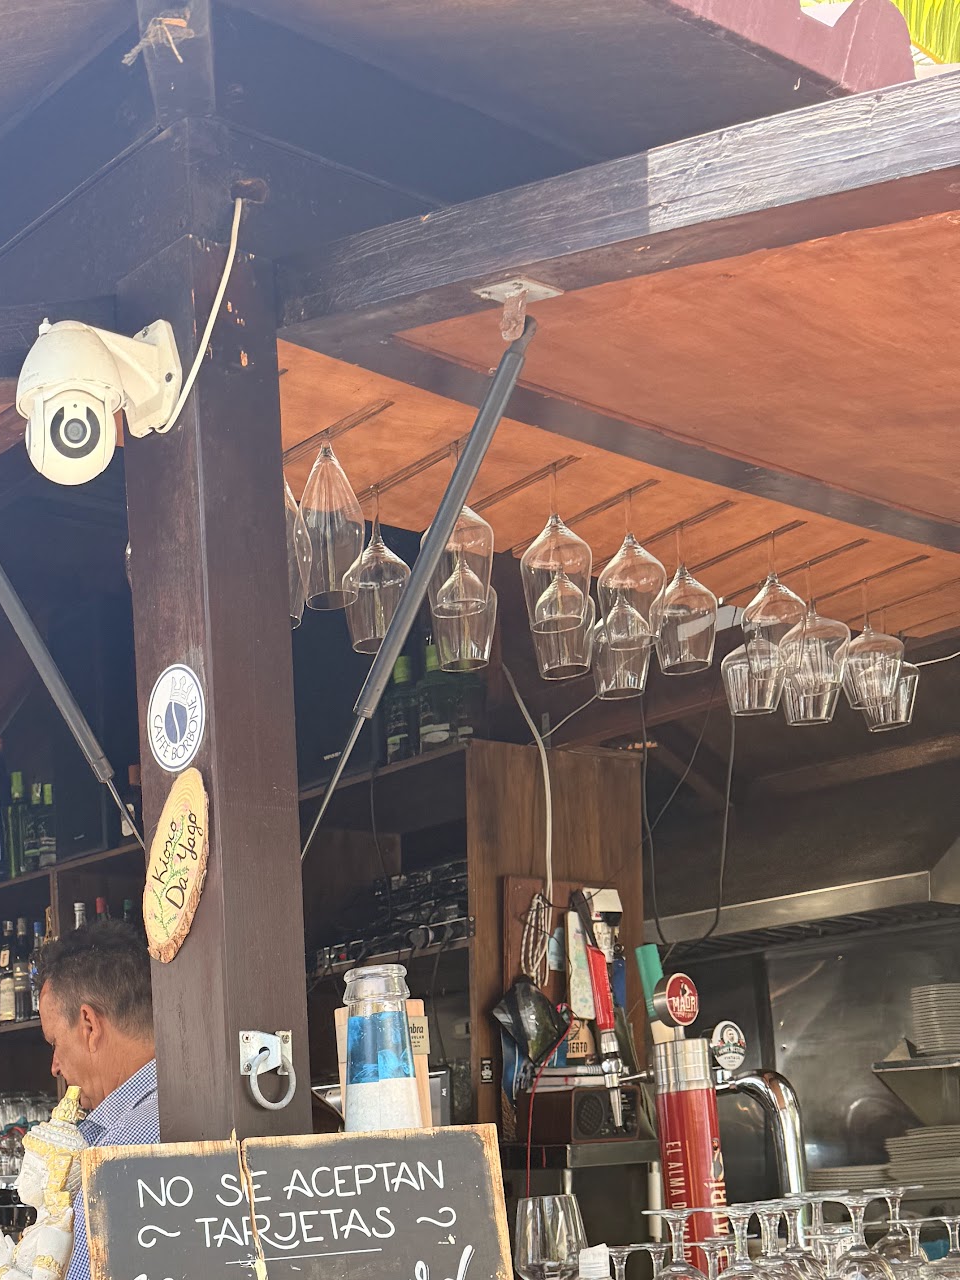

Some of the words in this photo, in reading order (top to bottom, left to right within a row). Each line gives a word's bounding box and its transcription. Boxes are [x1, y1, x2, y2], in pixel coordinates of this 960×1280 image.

[153, 714, 171, 758] CAFFÈ
[171, 696, 198, 760] BORBONE
[152, 821, 177, 884] Kiosco
[165, 877, 189, 909] Da
[177, 809, 203, 860] Yago
[569, 1041, 588, 1054] IERTO
[665, 1141, 682, 1156] EL
[137, 1175, 194, 1209] NO
[216, 1169, 271, 1208] SE
[283, 1159, 445, 1201] ACEPTAN
[667, 1162, 686, 1196] ALMA
[195, 1206, 396, 1251] TARJETAS
